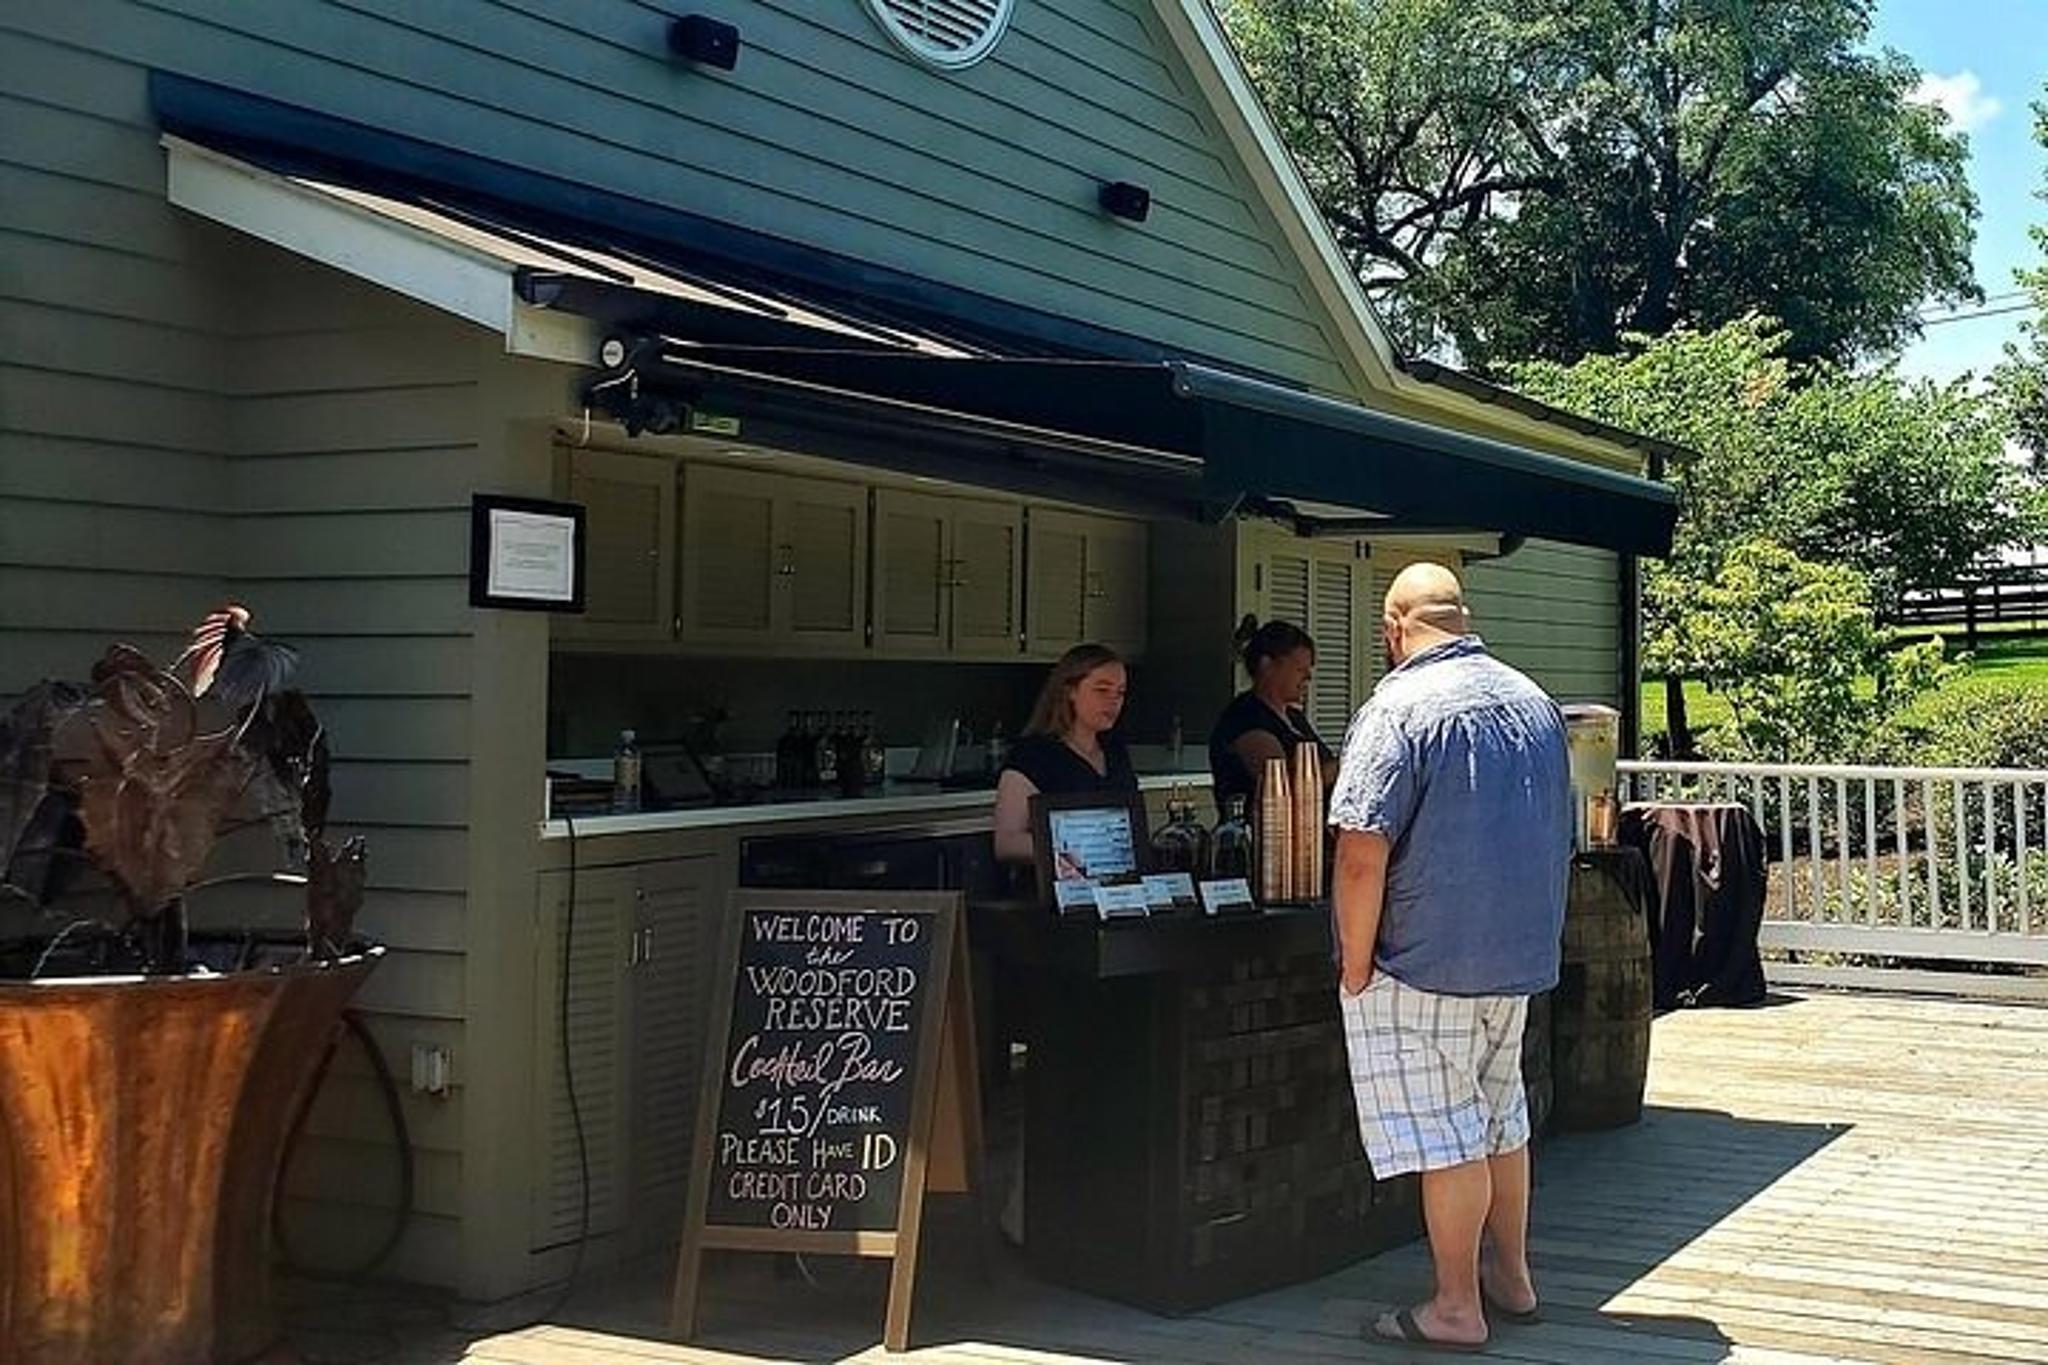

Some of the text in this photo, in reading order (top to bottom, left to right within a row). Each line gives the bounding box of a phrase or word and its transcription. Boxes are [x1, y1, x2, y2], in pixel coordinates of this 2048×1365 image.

[753, 915, 919, 944] WELCOME TO
[807, 946, 854, 966] the
[747, 967, 916, 996] WOODFORD
[765, 998, 910, 1031] RESERVE
[731, 1031, 903, 1091] Cocktail Bar
[721, 1134, 800, 1165] PLEASE
[862, 1134, 896, 1169] ID
[729, 1172, 866, 1201] CREDIT CARD
[771, 1202, 832, 1229] ONLY
